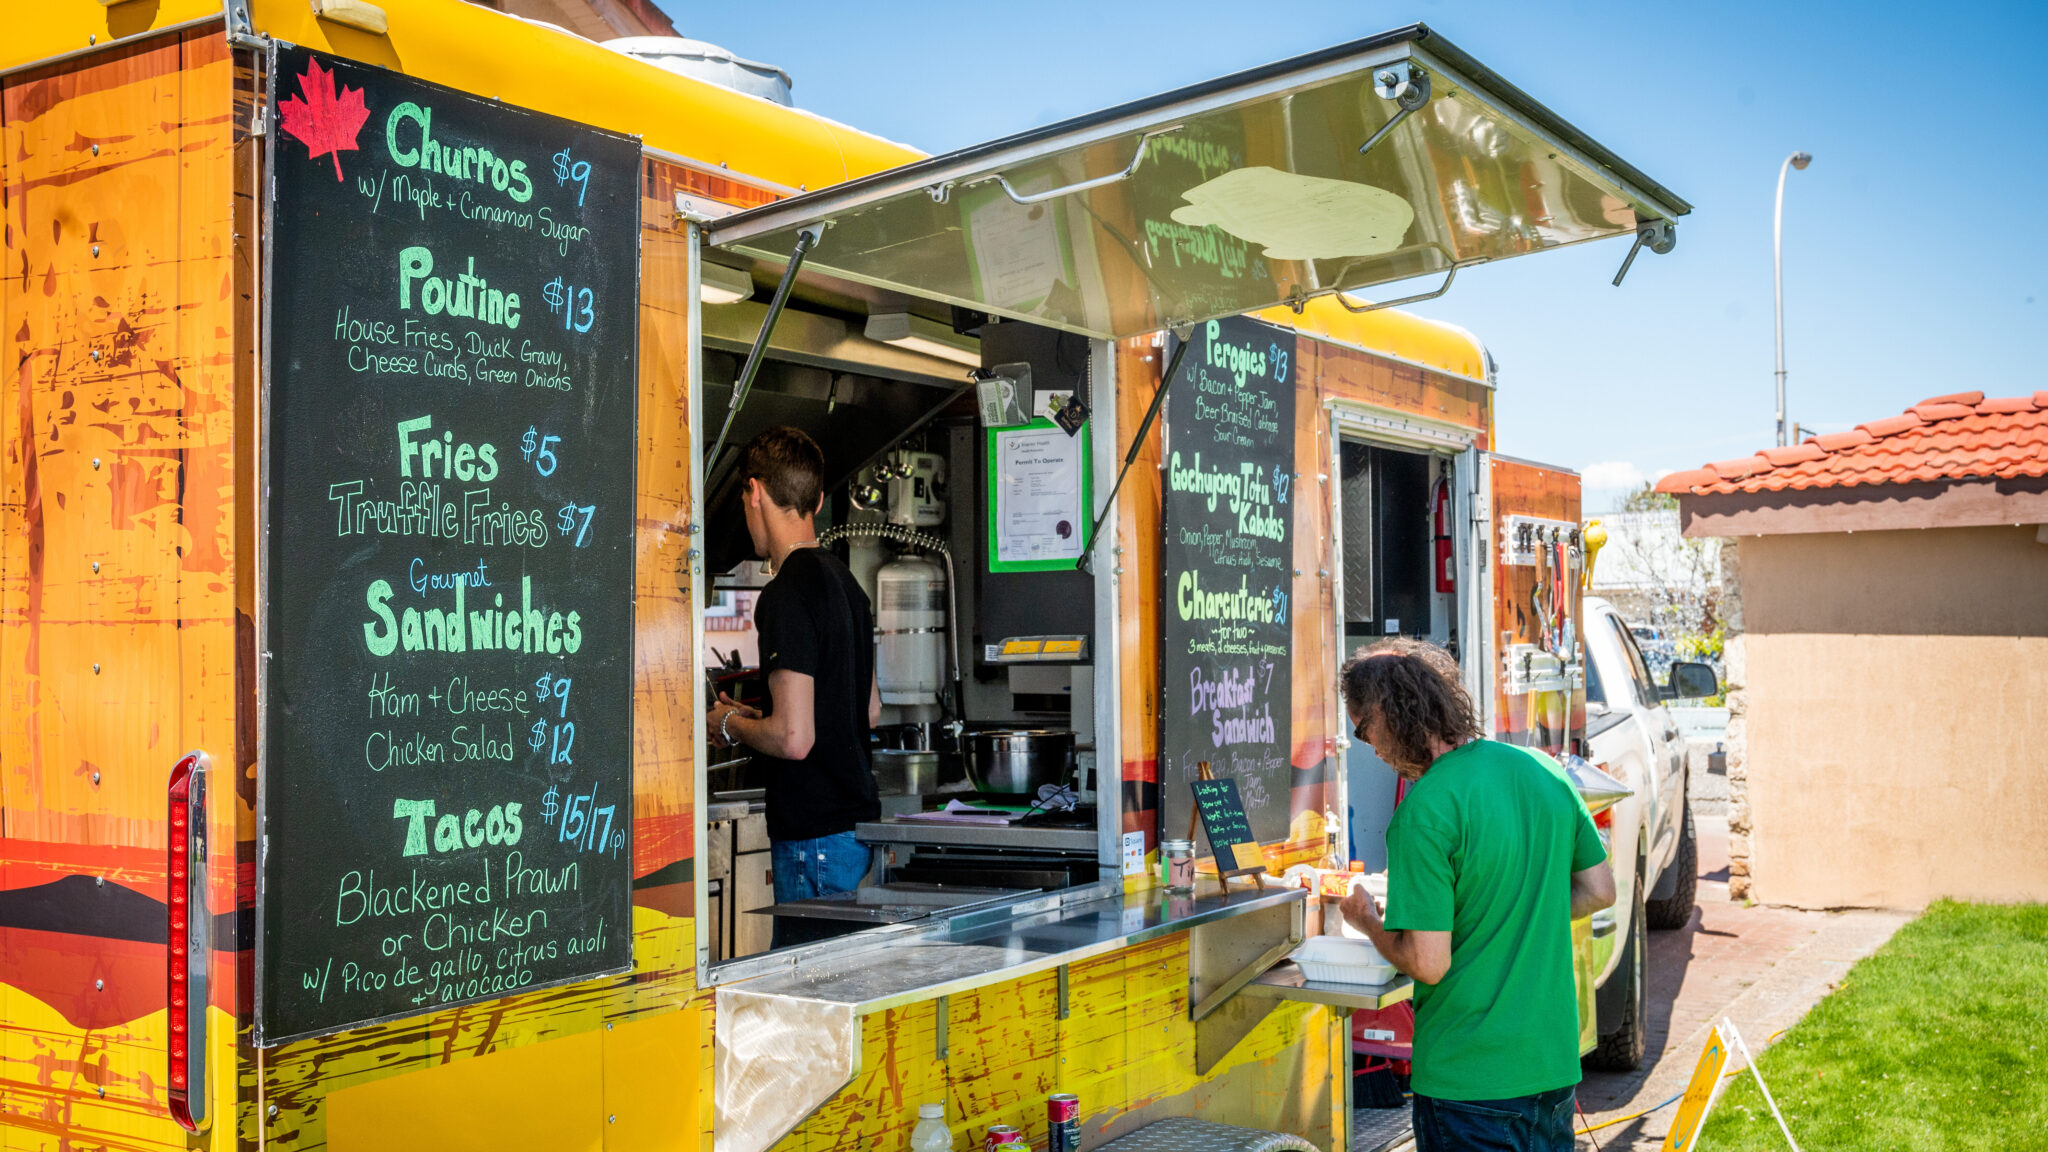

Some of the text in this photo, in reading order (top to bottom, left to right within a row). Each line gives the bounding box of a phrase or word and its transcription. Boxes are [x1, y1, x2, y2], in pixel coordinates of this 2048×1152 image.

[387, 102, 592, 206] Churros $9
[393, 175, 442, 220] Maple
[460, 194, 532, 229] Cinnamon
[538, 207, 590, 256] Sugar
[400, 247, 594, 333] Poutine $13
[335, 305, 399, 344] House
[404, 319, 460, 358] Fries,
[465, 332, 510, 358] Duck
[1206, 320, 1288, 388] Perogies $13
[349, 345, 417, 374] Cheese
[475, 359, 517, 384] Green
[1200, 369, 1226, 395] Bacon
[1235, 385, 1258, 411] Pepper
[1195, 396, 1220, 420] Beer
[1221, 403, 1252, 428] Braised
[1214, 424, 1232, 442] Sour
[1232, 426, 1254, 448] Cream
[398, 414, 561, 481] Fries $5
[1171, 451, 1240, 514] Gochujang
[1241, 463, 1270, 505] Tofu
[329, 480, 596, 548] Truffle Fries $7
[1238, 502, 1284, 542] Kabobs
[410, 558, 492, 598] Gourmet
[1214, 548, 1236, 566] Citrus
[364, 576, 582, 656] Sandwiches
[1178, 570, 1287, 624] Charcuterie $21
[1188, 639, 1195, 654] 3
[368, 672, 572, 718] Ham + Cheese $9
[1190, 659, 1274, 716] Breakfast $7
[366, 718, 575, 771] Chicken Salad $12
[1212, 702, 1274, 748] Sandwich
[394, 799, 522, 857] Tacos
[336, 851, 578, 927] Blackened Prawn
[382, 907, 547, 956] or Chicken
[303, 957, 332, 1003] w/
[342, 962, 386, 992] Pico
[393, 956, 423, 985] de
[496, 939, 558, 970] citrus
[567, 917, 607, 954] aioli
[441, 969, 532, 1002] avocado
